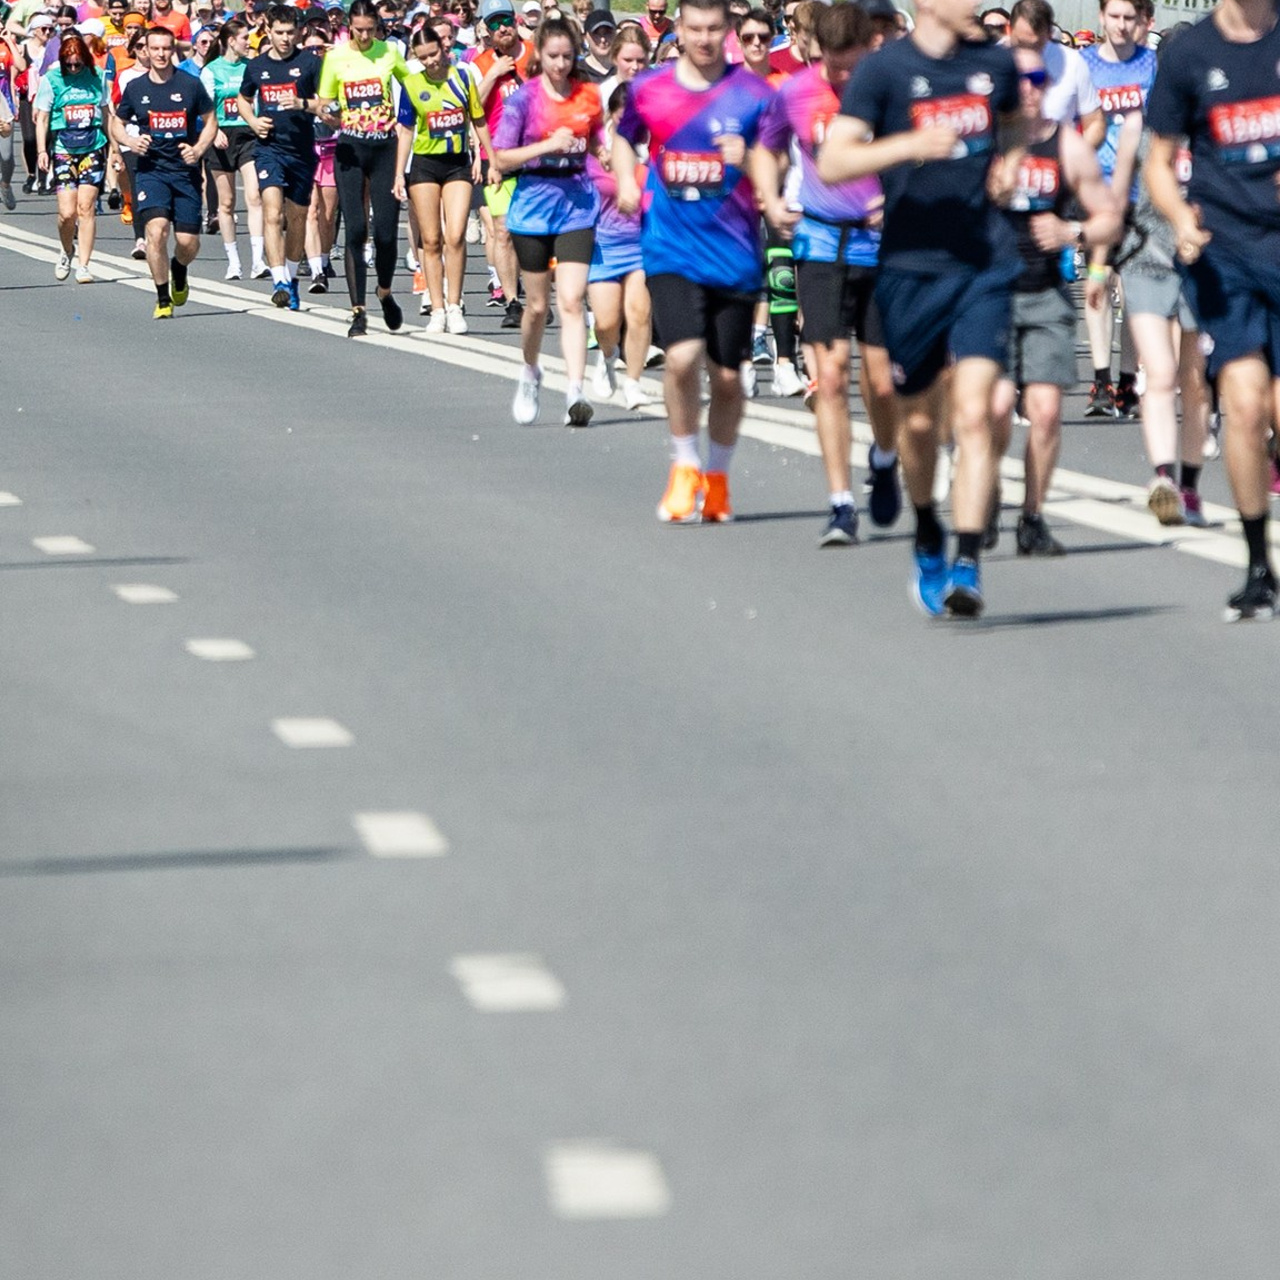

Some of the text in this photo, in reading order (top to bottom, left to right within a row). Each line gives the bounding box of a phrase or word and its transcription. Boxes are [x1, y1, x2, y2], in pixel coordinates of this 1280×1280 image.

[346, 83, 382, 99] 14282
[1102, 91, 1141, 111] 6143
[152, 117, 185, 128] 12689
[430, 112, 464, 129] 14283
[667, 160, 723, 183] 17572
